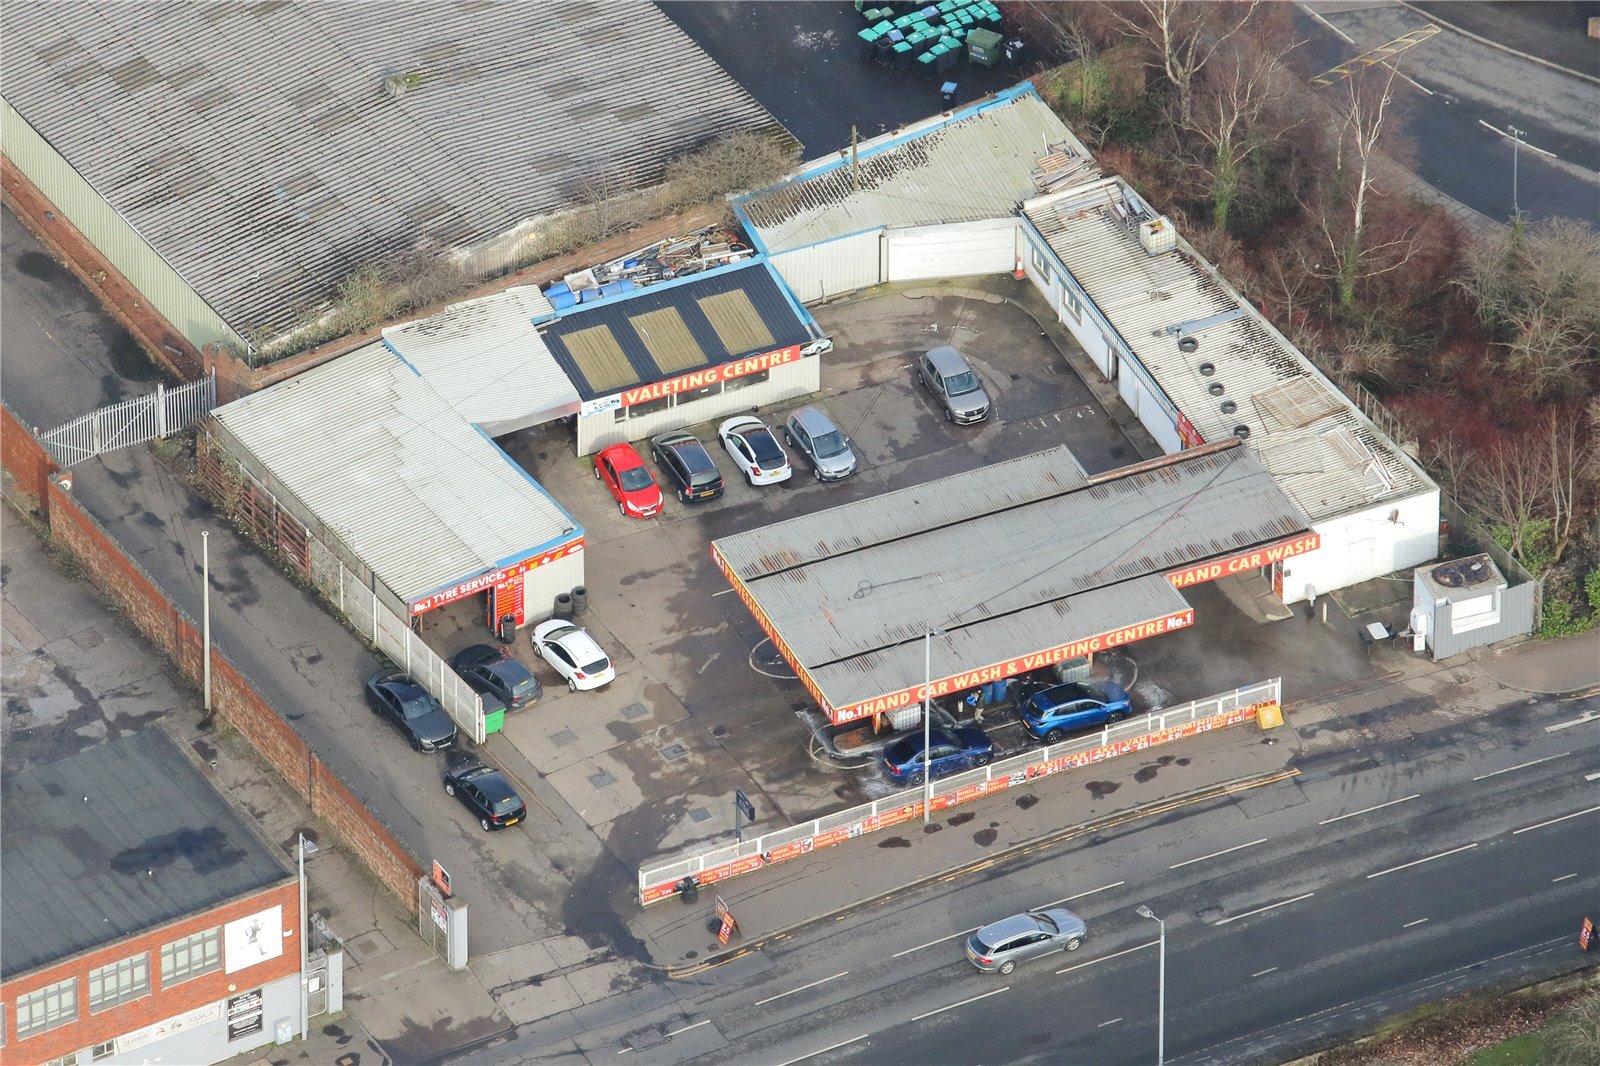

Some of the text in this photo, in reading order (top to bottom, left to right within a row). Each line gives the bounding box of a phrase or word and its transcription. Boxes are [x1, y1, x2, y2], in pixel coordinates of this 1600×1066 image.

[626, 350, 792, 404] VALETING CENTRE
[1171, 537, 1317, 587] HAND CAR WASH
[414, 600, 431, 613] No.1
[433, 588, 458, 604] TYRE
[460, 570, 503, 594] SERVICE
[725, 564, 774, 640] PROFESSIONAL
[775, 632, 795, 668] VALET
[795, 664, 822, 705] CENTRE
[837, 612, 1192, 722] No.1 HAND CAR WASH & VALETING CENTRE No.1
[1212, 710, 1240, 722] SUPER
[1227, 715, 1242, 725] £15
[1182, 718, 1211, 730] MINI
[1152, 727, 1180, 738] WASH
[1168, 733, 1180, 741] £9
[1125, 736, 1147, 746] VAN
[1064, 753, 1087, 763] CAR
[1033, 761, 1058, 770] TAXI
